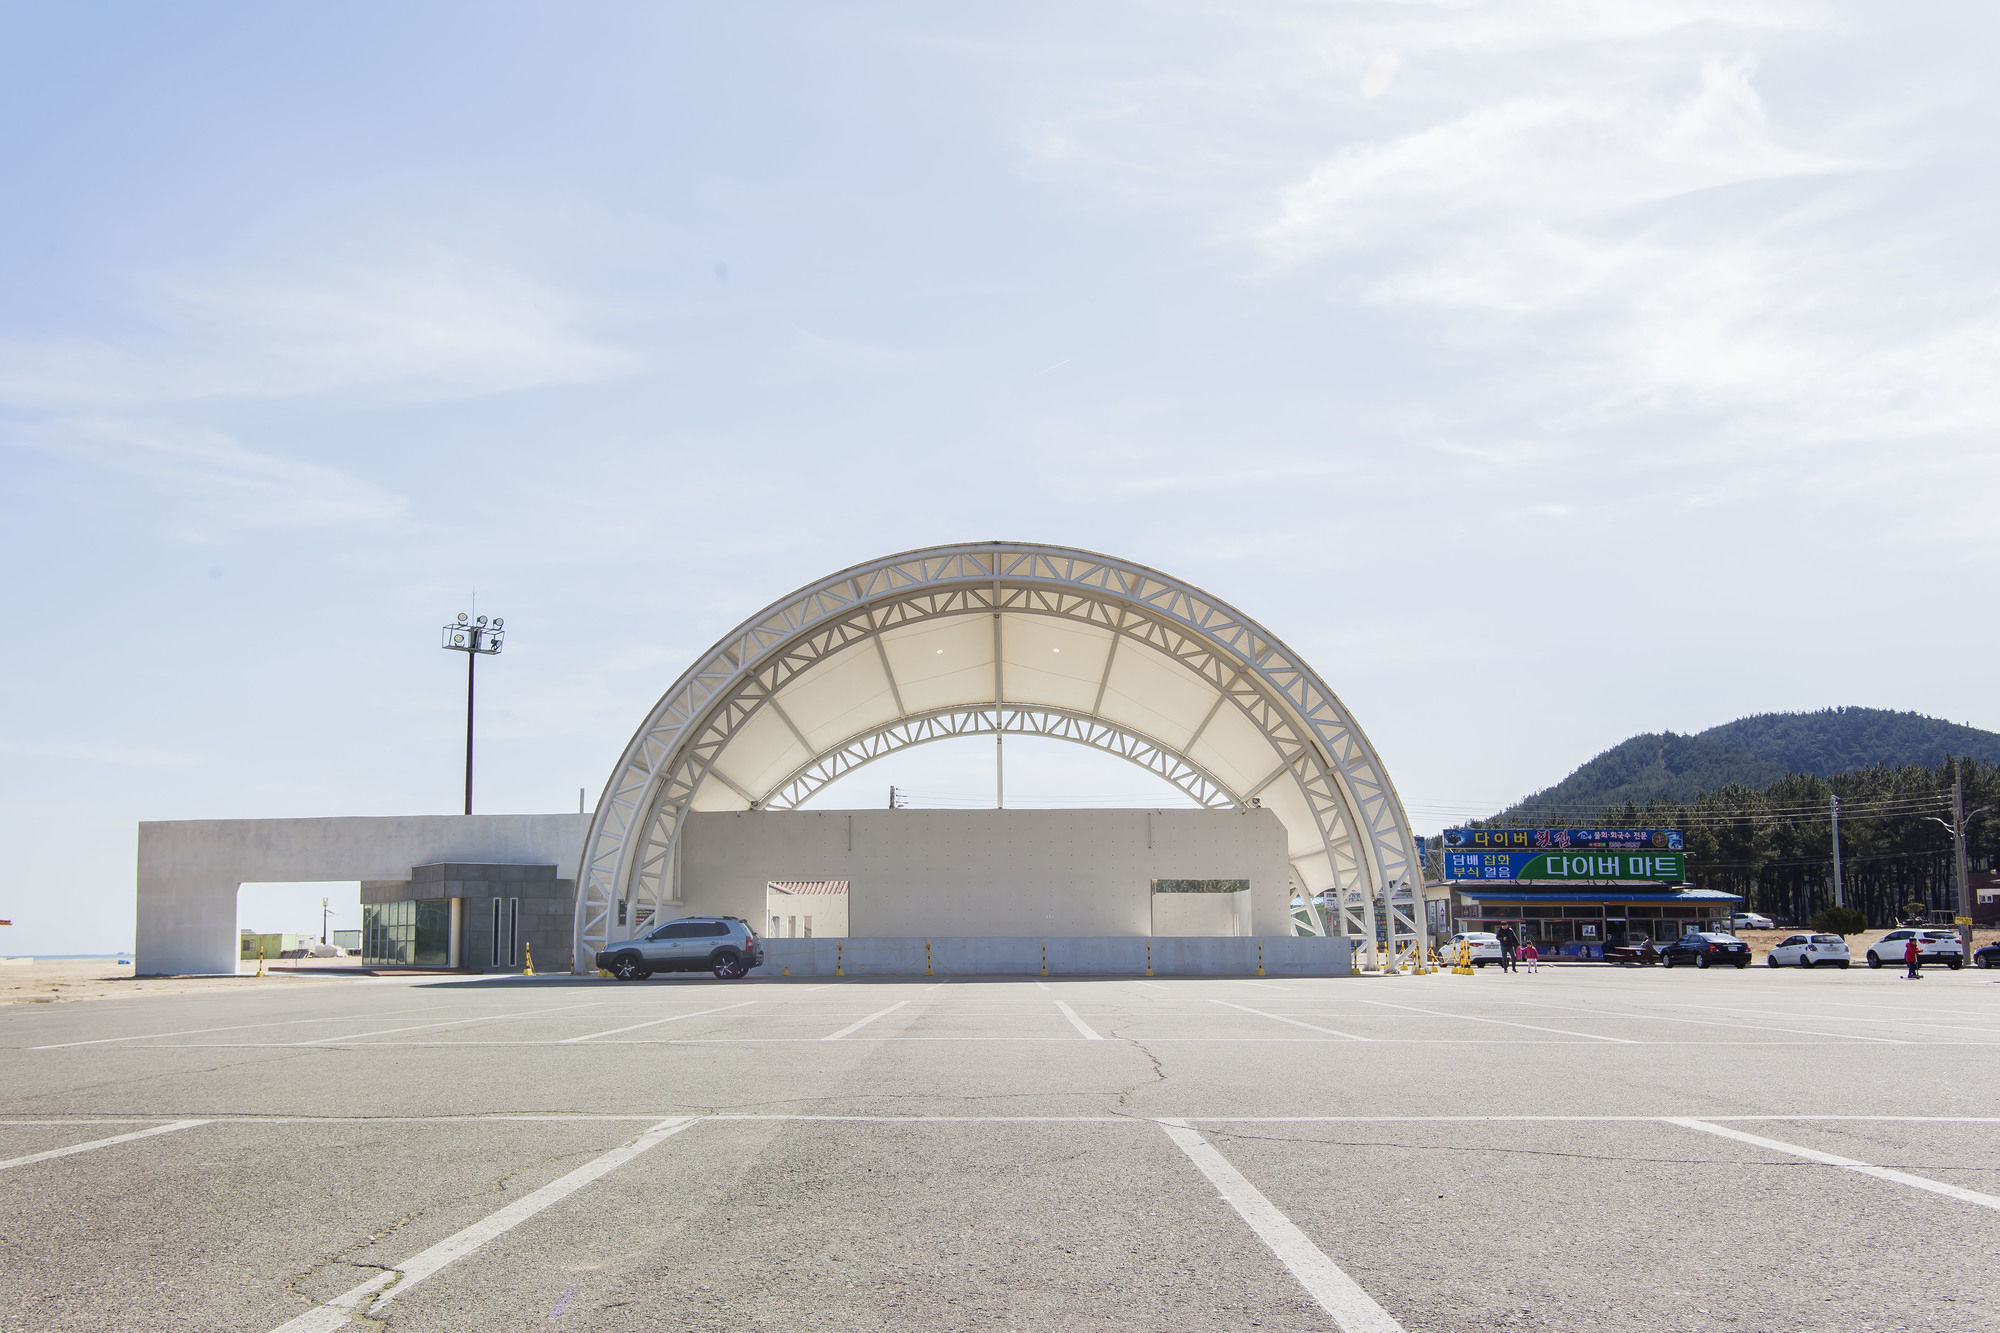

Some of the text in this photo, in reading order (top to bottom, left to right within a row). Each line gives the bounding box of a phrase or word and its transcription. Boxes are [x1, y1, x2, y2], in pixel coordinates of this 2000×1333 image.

[1475, 830, 1571, 848] 다이버 횟집
[1633, 831, 1648, 840] 전문
[1452, 854, 1511, 866] 담배 잡화
[1453, 866, 1511, 878] 부식 얼음
[1546, 856, 1679, 877] 다이버 마트
